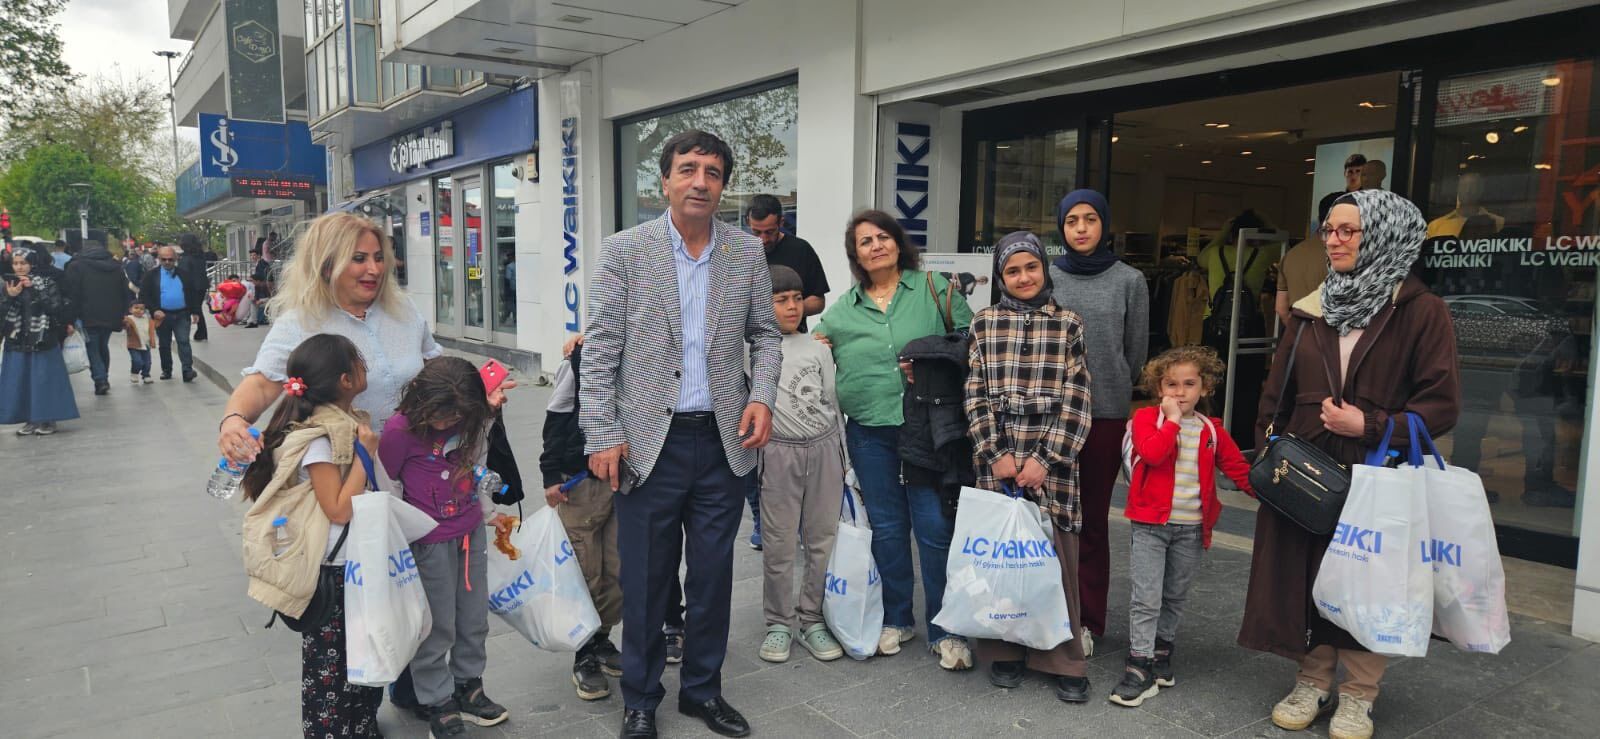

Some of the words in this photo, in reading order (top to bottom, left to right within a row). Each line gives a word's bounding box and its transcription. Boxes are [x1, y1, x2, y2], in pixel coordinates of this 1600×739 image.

[1434, 240, 1457, 254] LC
[1546, 236, 1572, 250] LC
[1520, 252, 1545, 266] LC
[565, 282, 581, 333] LC
[555, 540, 573, 566] LC
[962, 537, 990, 556] LC
